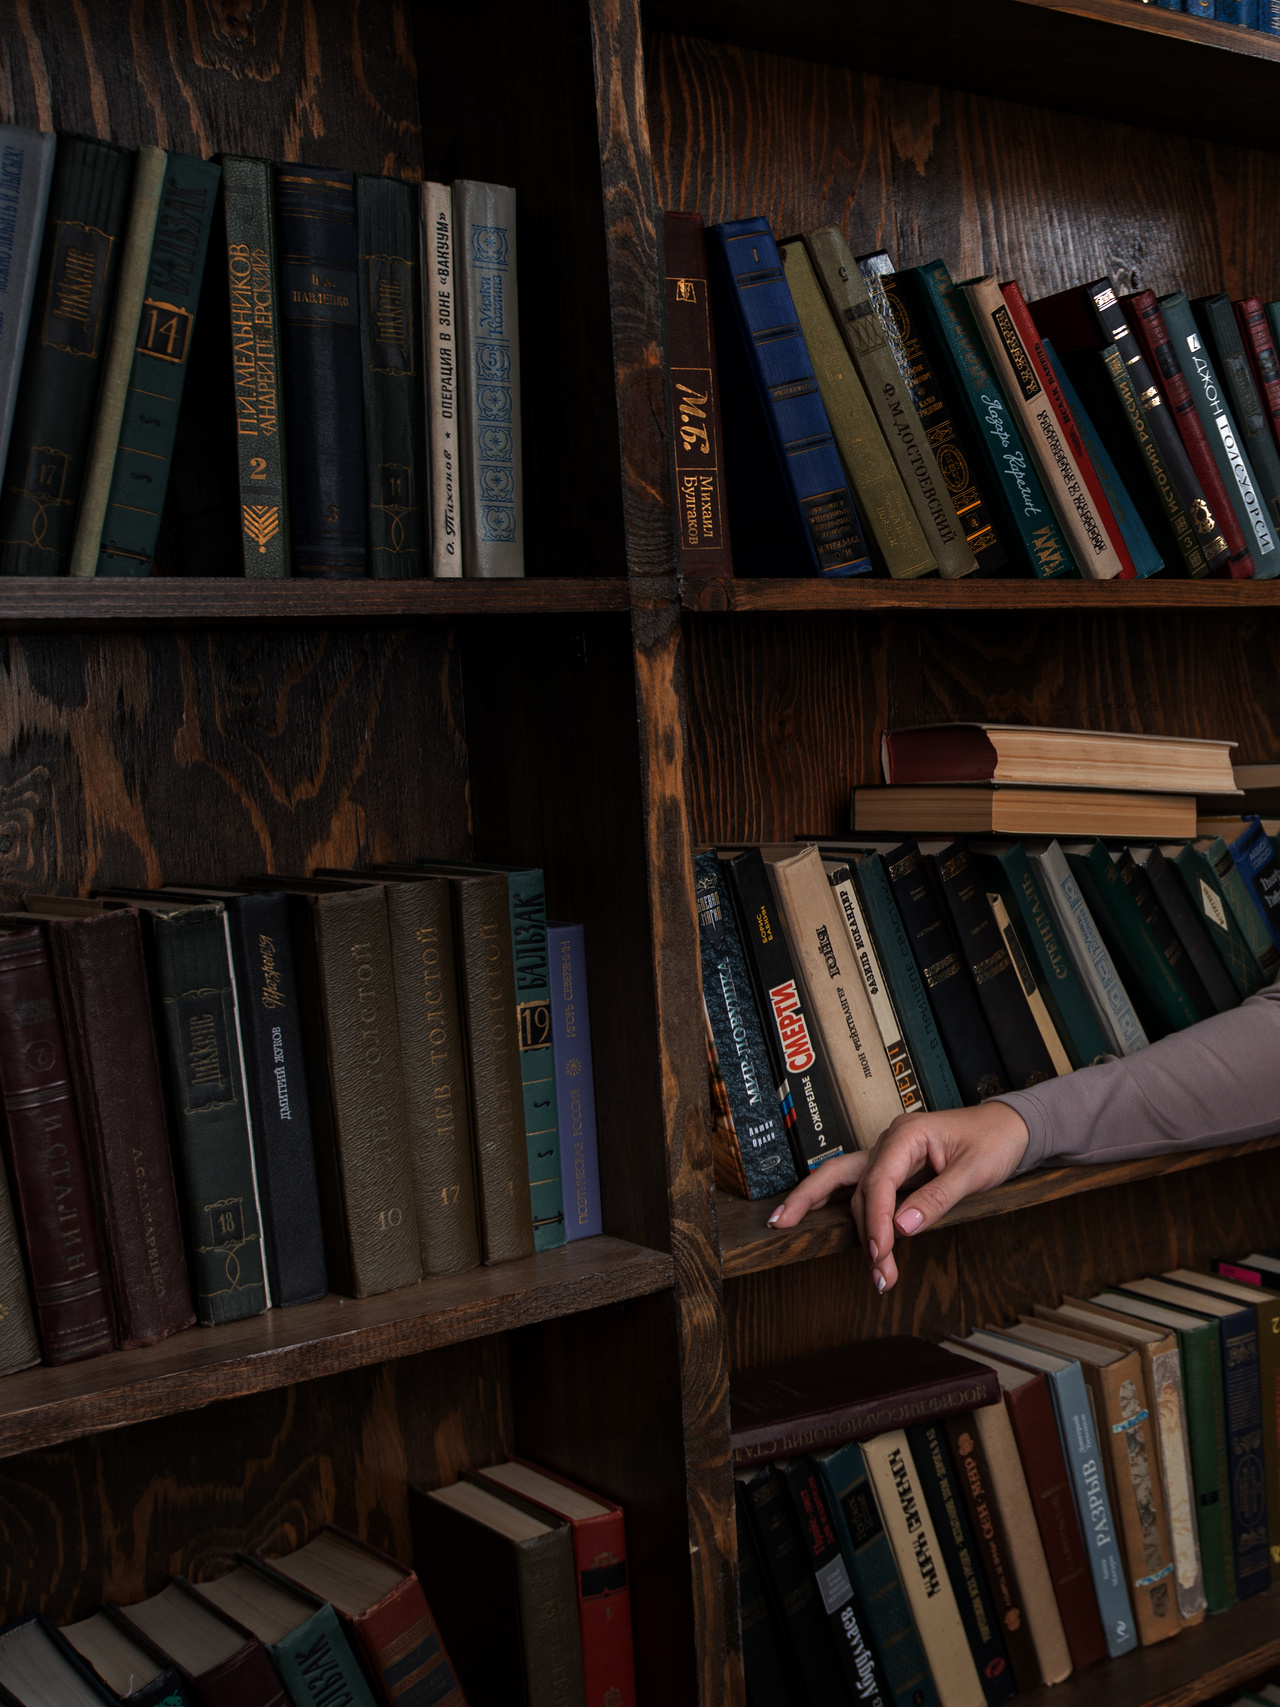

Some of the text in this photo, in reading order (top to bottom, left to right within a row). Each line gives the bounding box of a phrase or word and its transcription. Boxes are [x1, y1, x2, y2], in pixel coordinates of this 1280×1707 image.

[3, 145, 23, 193] ЛЫСЫХ!
[0, 203, 17, 250] ЛЮБИТЬ
[148, 177, 208, 295] БАЛЬЗАК
[437, 212, 450, 285] «ВАКУУМ»
[50, 246, 98, 332] Диккенс
[230, 243, 256, 387] МЕЛЬНИКОВ
[292, 291, 349, 309] ПАВЛЕНКО
[376, 277, 407, 352] Диккенс
[440, 290, 451, 328] ЗОНЕ
[479, 277, 493, 326] Уилки
[488, 274, 503, 335] Коллинз
[147, 309, 180, 355] 14
[441, 332, 452, 342] В
[441, 347, 455, 419] ОПЕРАЦИЯ
[1032, 342, 1071, 424] ИСААК БАБЕЛЬ
[1118, 380, 1150, 441] РОССИИ
[250, 457, 267, 479] 2
[978, 390, 1043, 518] Лазарь Карелин
[1144, 443, 1179, 512] ИСТОРИЯ
[1191, 353, 1271, 548] ДЖОН ГОЛСУОРСИ
[326, 505, 339, 523] 3
[444, 449, 456, 536] Тихонов
[681, 475, 700, 544] Булгаков
[699, 475, 714, 537] Михаил
[813, 515, 852, 531] СОБРАНИЕ
[1071, 493, 1107, 554] ПОВЕСТИ
[1103, 483, 1126, 524] СЛОВАРЬ
[817, 534, 860, 553] ТУРГЕНЕВ
[820, 524, 851, 538] ПОЛНОЕ
[875, 505, 897, 547] ПОВЕСТИ
[512, 892, 547, 989] БАЛЬЗАК
[755, 912, 768, 943] БОРИС
[759, 904, 774, 940] БАБКИН
[839, 889, 879, 995] ФАЗИЛЬ ИСКАНДЕР
[879, 874, 910, 957] СВАСТИКА
[1018, 872, 1069, 980] СТЕНДАЛЬ
[350, 941, 383, 1085] ТОЛСТОЙ
[560, 940, 575, 1037] ИГОРЬ СЕВЕРЯНИН
[836, 986, 862, 1051] ФЕЙХТВАНГЕР
[189, 1012, 222, 1088] Диккенс
[416, 926, 454, 1140] ЛЕВ ТОЛСТОЙ
[522, 1006, 549, 1044] 19
[716, 955, 763, 1105] МИР-ЛОВУШКА
[272, 1026, 291, 1119] ДМИТРИЙ ЖУКОВ
[769, 981, 827, 1147] 2 ОЖЕРЕЛЬЕ СМЕРТИ
[857, 1052, 872, 1079] ЛИОН
[887, 1044, 916, 1106] BEST
[570, 1088, 588, 1224] ПОЭТИЧЕСКАЯ РОССИЯ
[217, 1211, 234, 1234] 18
[377, 1208, 401, 1230] 10
[441, 1184, 459, 1205] 17
[781, 1399, 924, 1448] ВИССАРИОНОВИЧ
[927, 1384, 987, 1410] ИОСИФ
[886, 1448, 942, 1597] ЖОРЖ СИМЕНОН
[1081, 1458, 1112, 1547] РАЗРЫВ
[836, 1604, 884, 1699] Абдуллаев
